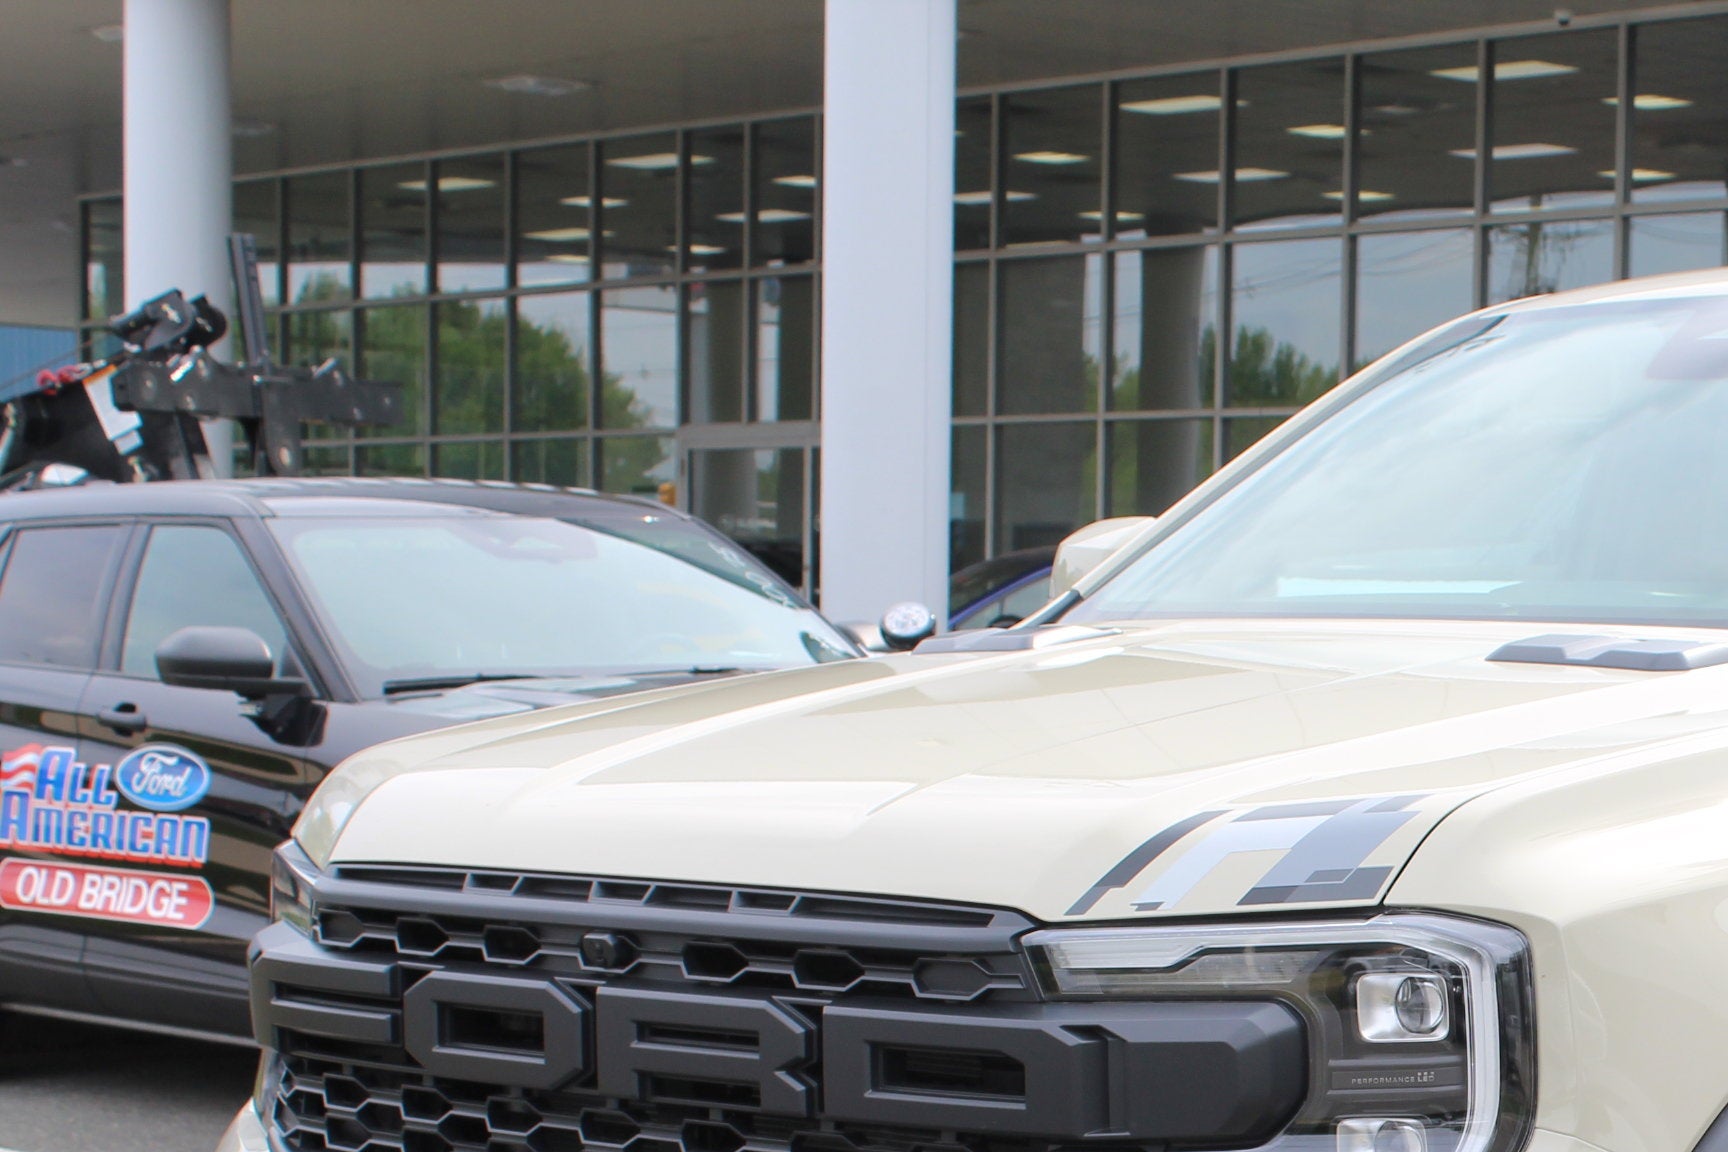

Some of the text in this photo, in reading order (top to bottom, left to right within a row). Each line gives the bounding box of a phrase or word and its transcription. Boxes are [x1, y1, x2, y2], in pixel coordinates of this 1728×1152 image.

[131, 752, 193, 797] Ford
[0, 787, 211, 866] AMERICAN
[16, 867, 188, 920] OLD BRIDGE
[251, 922, 1104, 1134] FORD
[1351, 1076, 1415, 1085] PERFORMANCE
